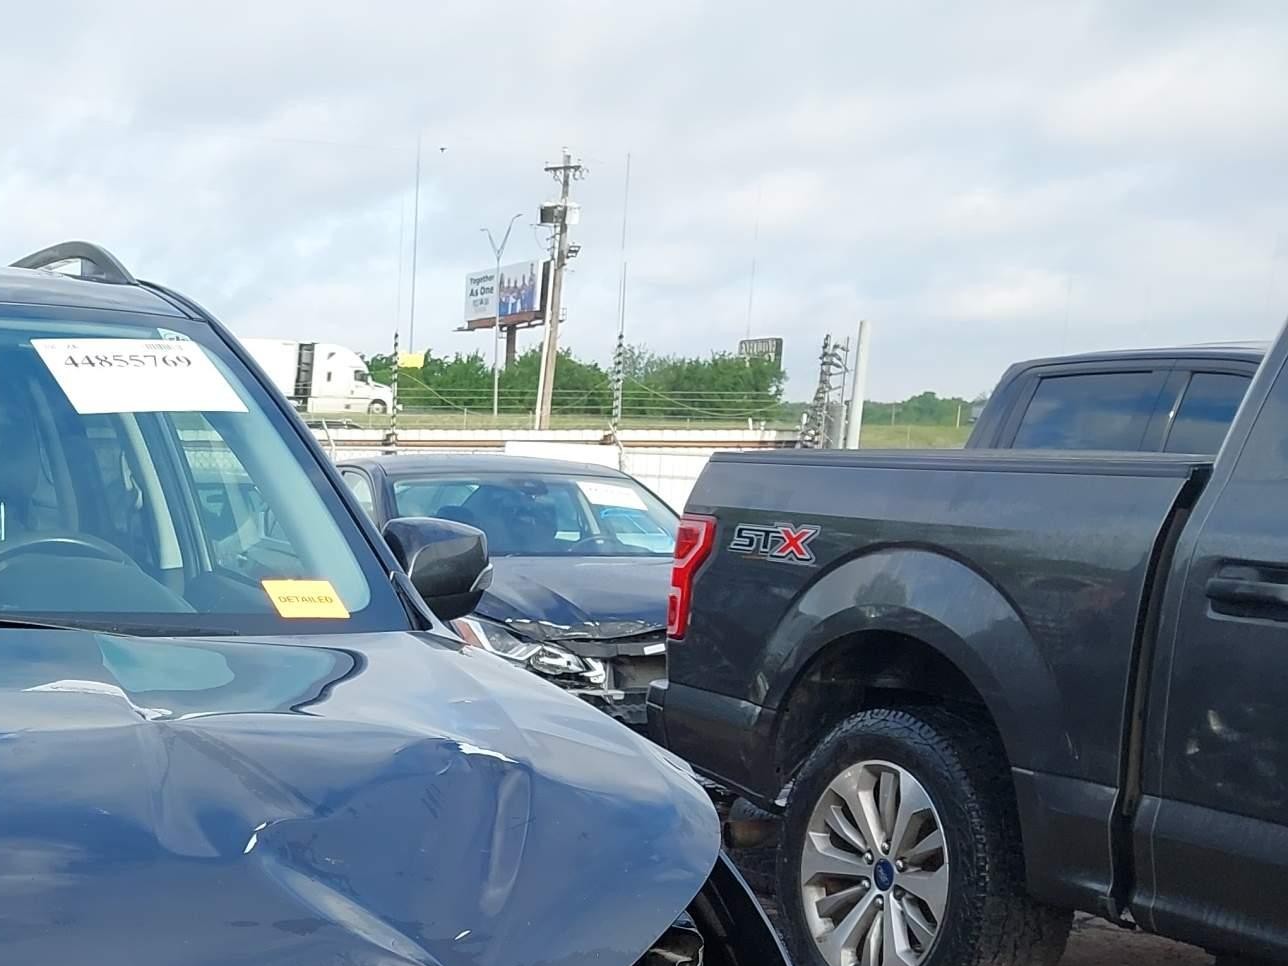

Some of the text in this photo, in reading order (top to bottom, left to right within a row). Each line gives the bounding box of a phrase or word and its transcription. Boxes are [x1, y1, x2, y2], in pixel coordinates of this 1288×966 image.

[469, 286, 494, 297] As One
[64, 354, 192, 368] 44855769
[729, 523, 819, 562] STX
[278, 595, 334, 604] DETAILED
